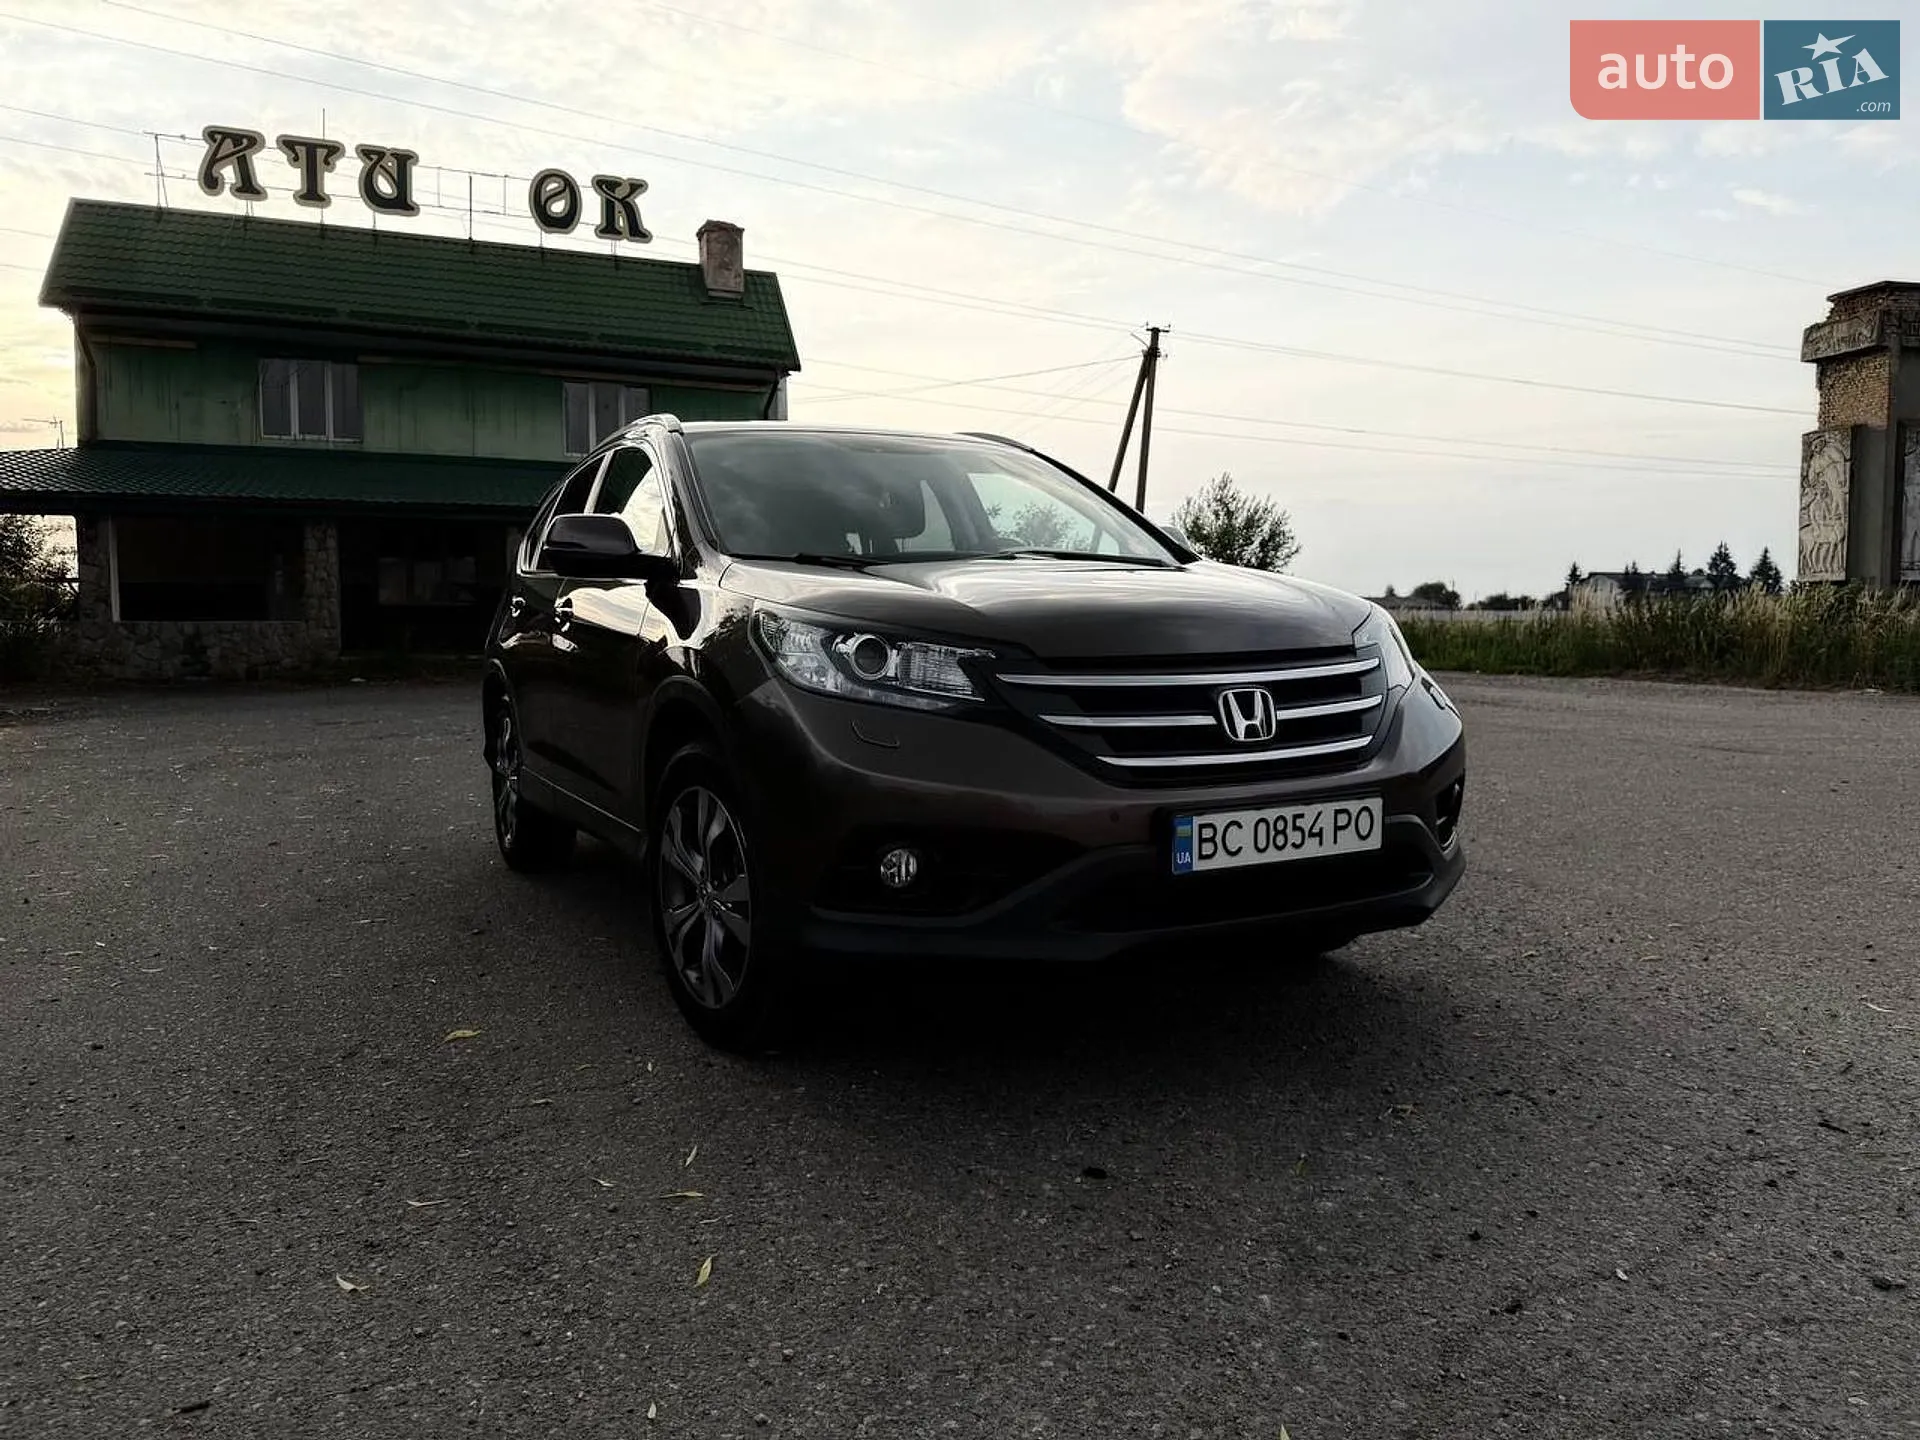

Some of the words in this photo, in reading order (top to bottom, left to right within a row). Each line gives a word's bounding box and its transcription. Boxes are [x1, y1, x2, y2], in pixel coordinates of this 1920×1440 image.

[1199, 820, 1243, 860] BC
[1253, 810, 1324, 853] 0854
[1333, 805, 1374, 845] PO
[1176, 852, 1191, 864] UA
